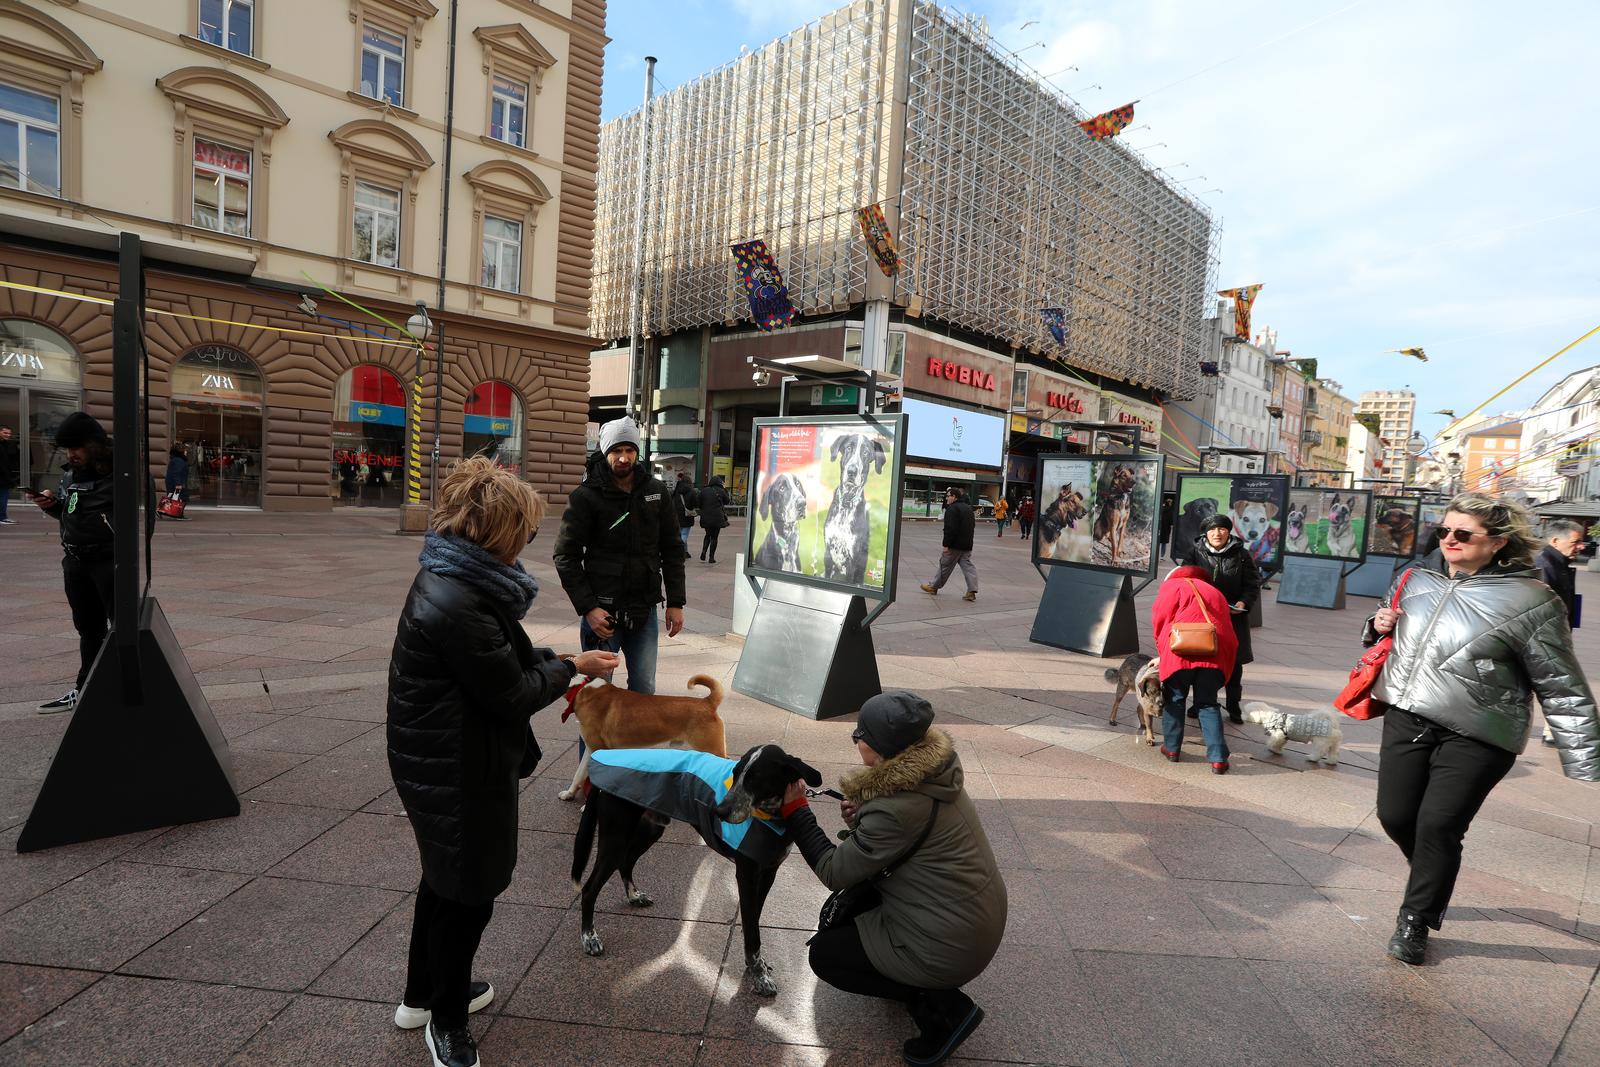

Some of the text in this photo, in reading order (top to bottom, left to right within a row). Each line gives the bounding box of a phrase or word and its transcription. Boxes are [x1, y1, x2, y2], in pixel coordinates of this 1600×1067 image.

[2, 352, 44, 370] ZARA
[201, 373, 234, 389] ZARA
[928, 357, 996, 392] ROBNA
[1047, 391, 1083, 414] KUĆA
[835, 386, 844, 398] D
